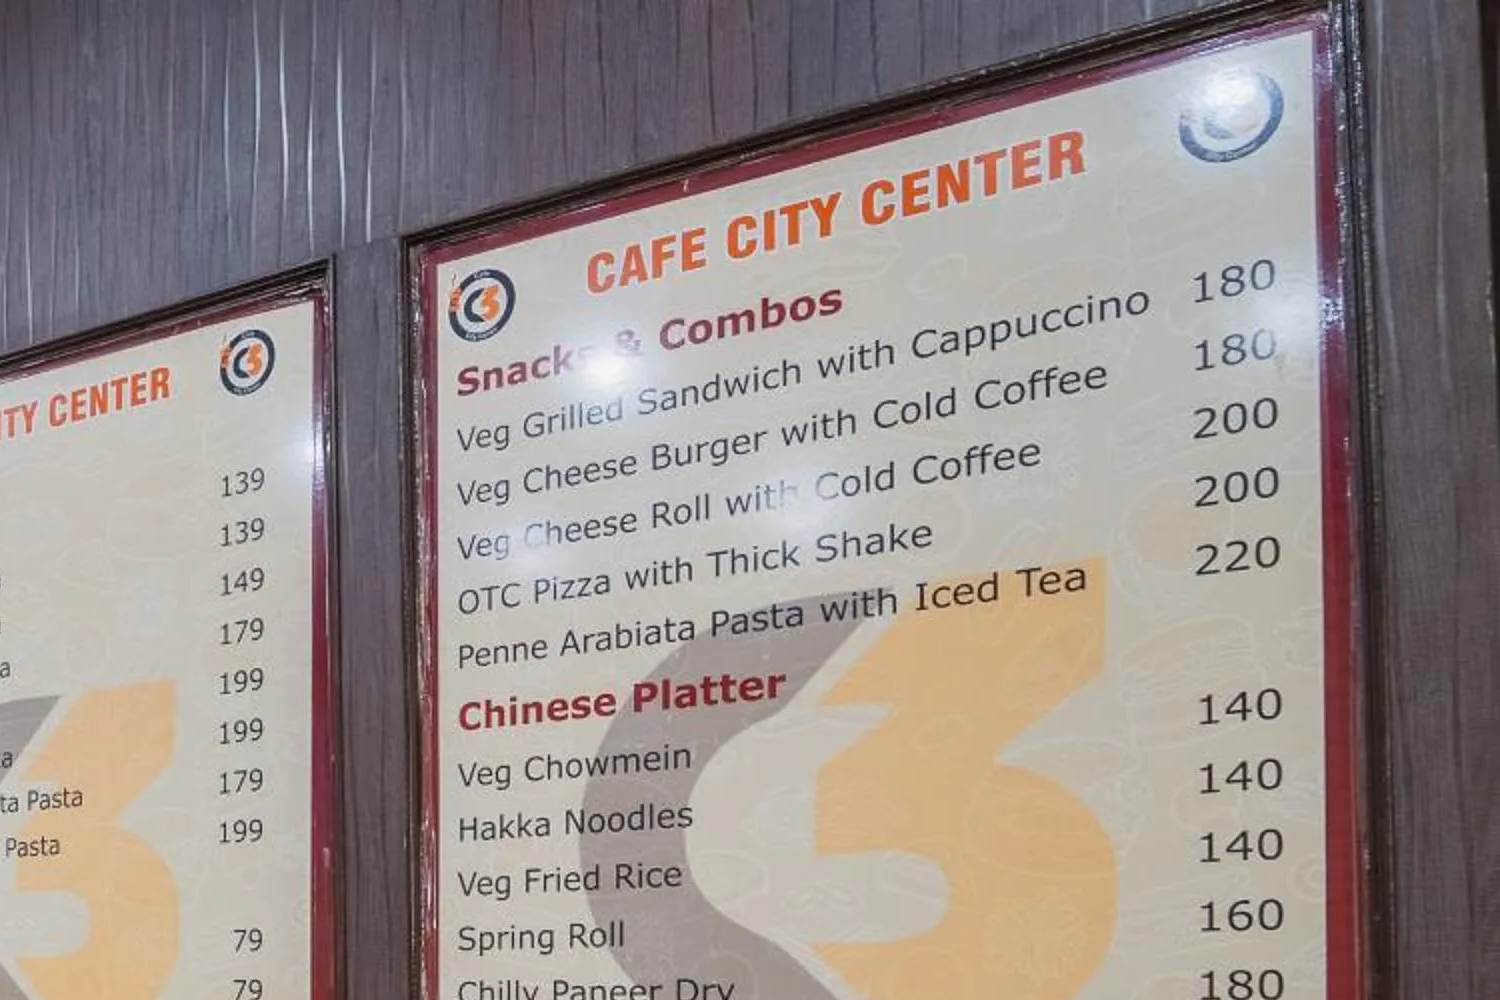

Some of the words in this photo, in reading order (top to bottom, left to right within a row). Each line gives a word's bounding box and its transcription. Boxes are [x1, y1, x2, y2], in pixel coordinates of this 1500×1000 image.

[588, 227, 705, 292] CAFE
[727, 192, 840, 258] CITY
[862, 131, 1084, 224] CENTER
[659, 289, 842, 349] Combos
[457, 425, 509, 451] Veg
[523, 401, 621, 437] Grilled
[639, 359, 800, 414] Sandwich
[817, 339, 893, 378] with
[912, 291, 1149, 358] Cappuccino
[1193, 259, 1274, 302] 180
[49, 367, 169, 426] CENTER
[222, 467, 264, 497] 139
[221, 517, 263, 546] 139
[459, 639, 547, 668] Penne
[560, 617, 694, 655] Arabiata
[712, 603, 803, 636] Pasta
[820, 587, 896, 621] with
[915, 571, 998, 610] Iced
[1015, 566, 1085, 596] Tea
[1196, 536, 1280, 575] 220
[220, 667, 263, 694] 199
[458, 693, 616, 730] Chinese
[633, 674, 785, 712] Platter
[220, 717, 263, 744] 199
[27, 787, 82, 810] Pasta
[220, 768, 262, 794] 179
[459, 812, 550, 842] Hakka
[565, 803, 692, 834] Noodles
[1200, 758, 1282, 794] 140
[457, 871, 510, 900] Veg
[525, 864, 599, 892] Fried
[615, 862, 681, 888] Rice
[1200, 829, 1282, 862] 140
[458, 924, 553, 956] Spring
[569, 920, 623, 948] Roll
[1201, 898, 1283, 931] 160
[1200, 969, 1283, 1000] 180
